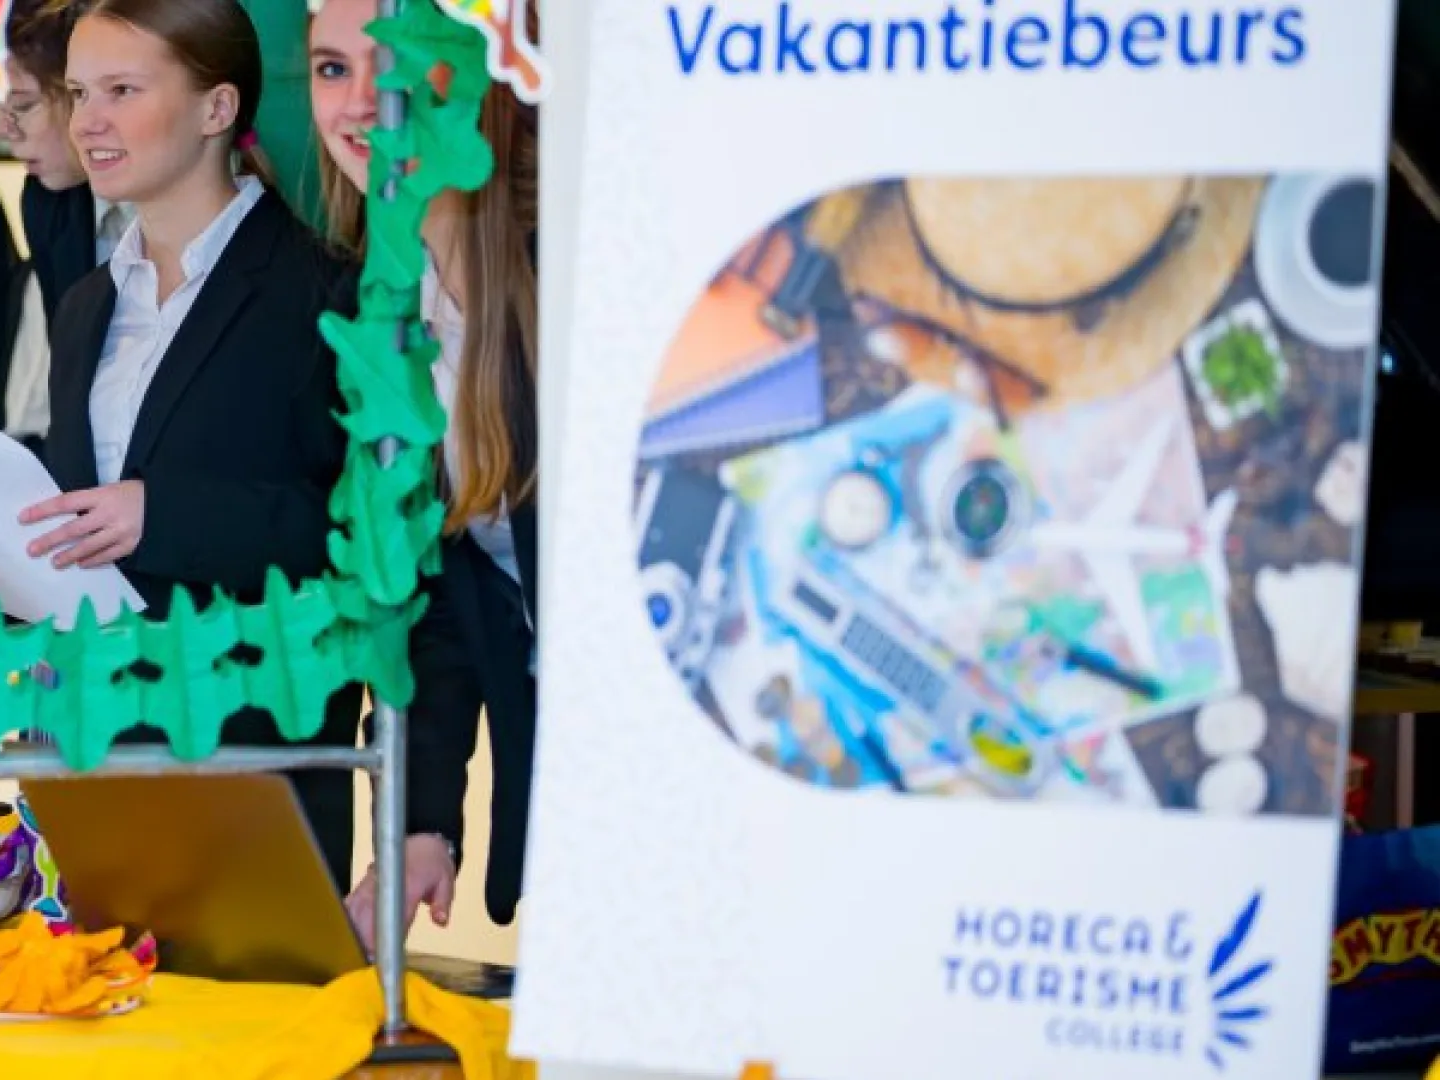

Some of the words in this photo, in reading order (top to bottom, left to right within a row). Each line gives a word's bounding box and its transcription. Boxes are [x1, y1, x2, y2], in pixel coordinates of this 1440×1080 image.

[666, 0, 1308, 75] Vakantiebeurs
[955, 908, 1152, 952] HORECA
[943, 957, 1186, 1013] TOERISME
[1045, 1017, 1184, 1055] COLLEGE
